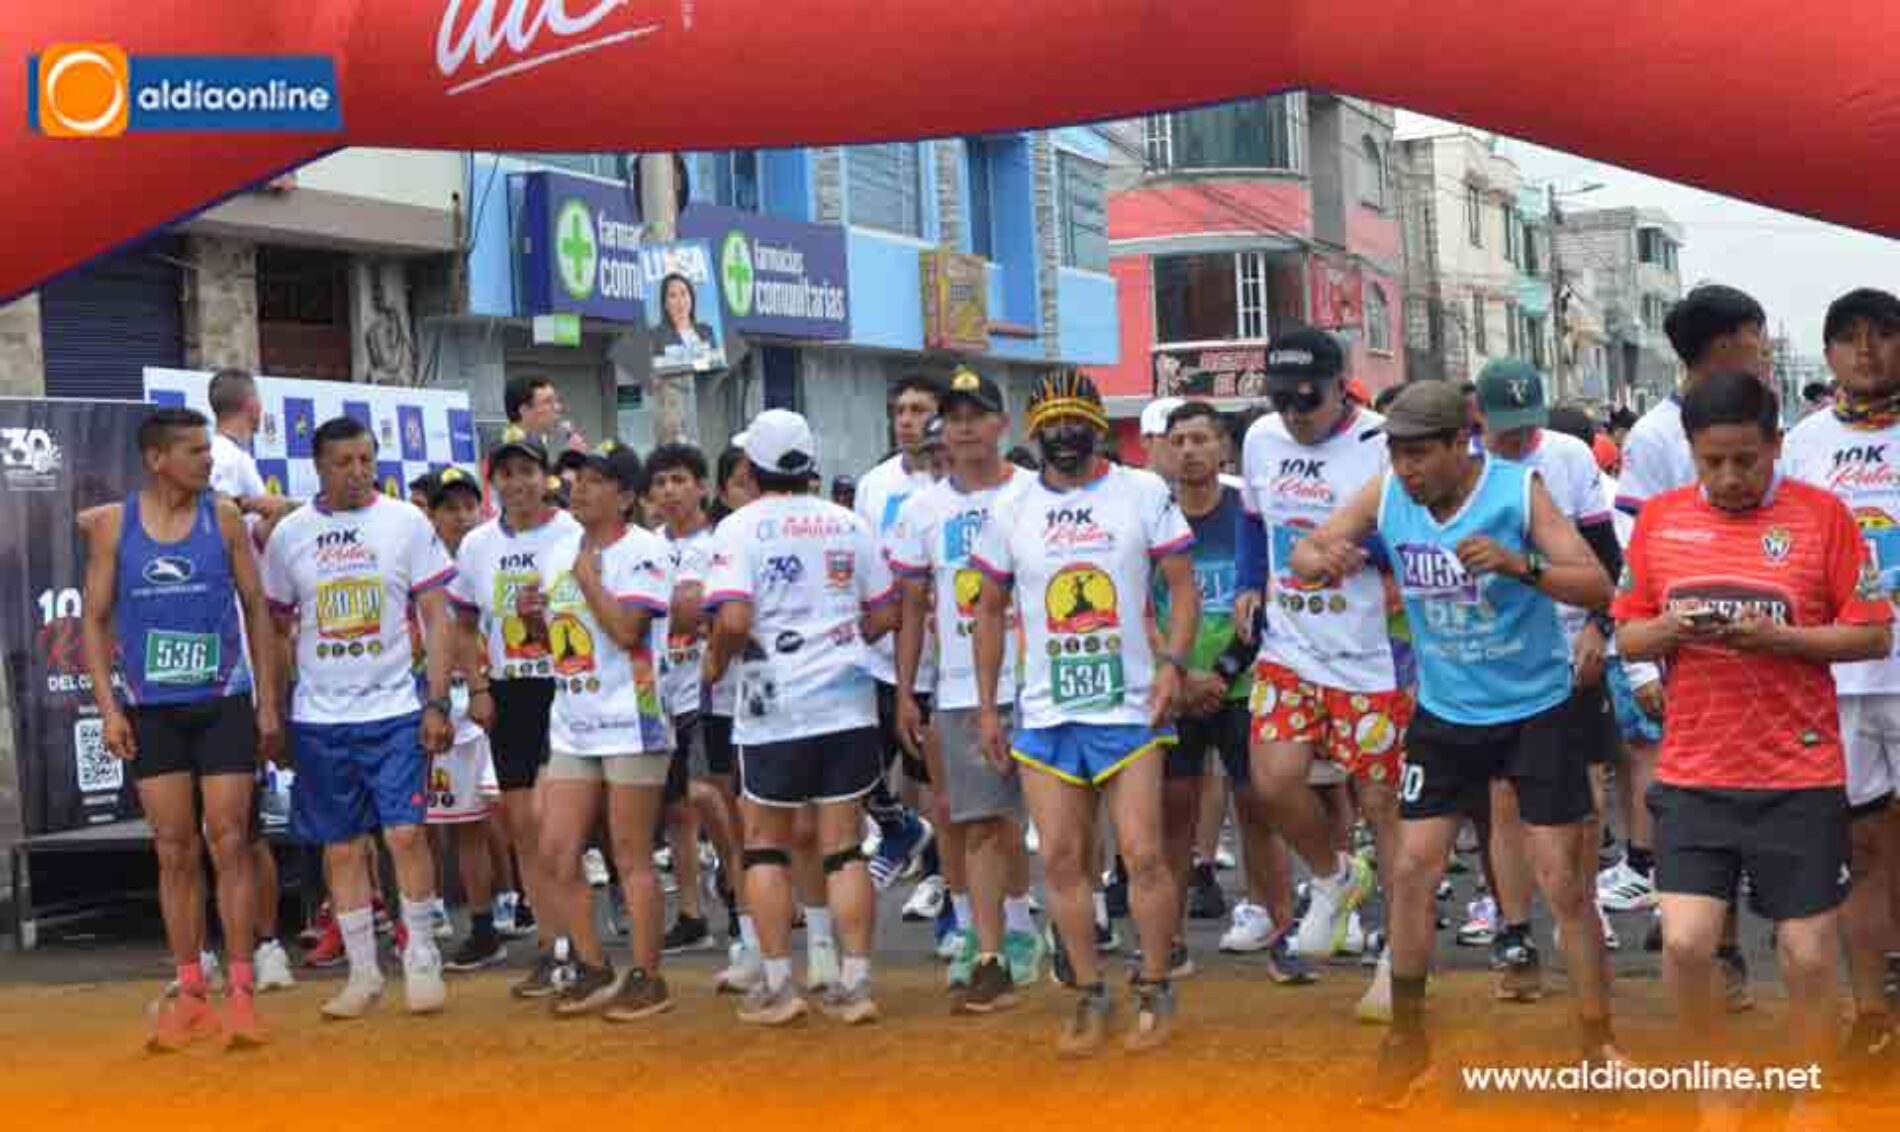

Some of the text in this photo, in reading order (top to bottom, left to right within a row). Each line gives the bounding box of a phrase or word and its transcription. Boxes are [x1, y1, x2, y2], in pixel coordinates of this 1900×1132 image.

[1834, 444, 1887, 467] 10K
[1280, 459, 1326, 479] 10K
[1045, 508, 1093, 528] 10K
[316, 529, 358, 548] 10K
[156, 639, 207, 668] 536
[47, 674, 78, 692] DEL
[1060, 664, 1112, 697] 534
